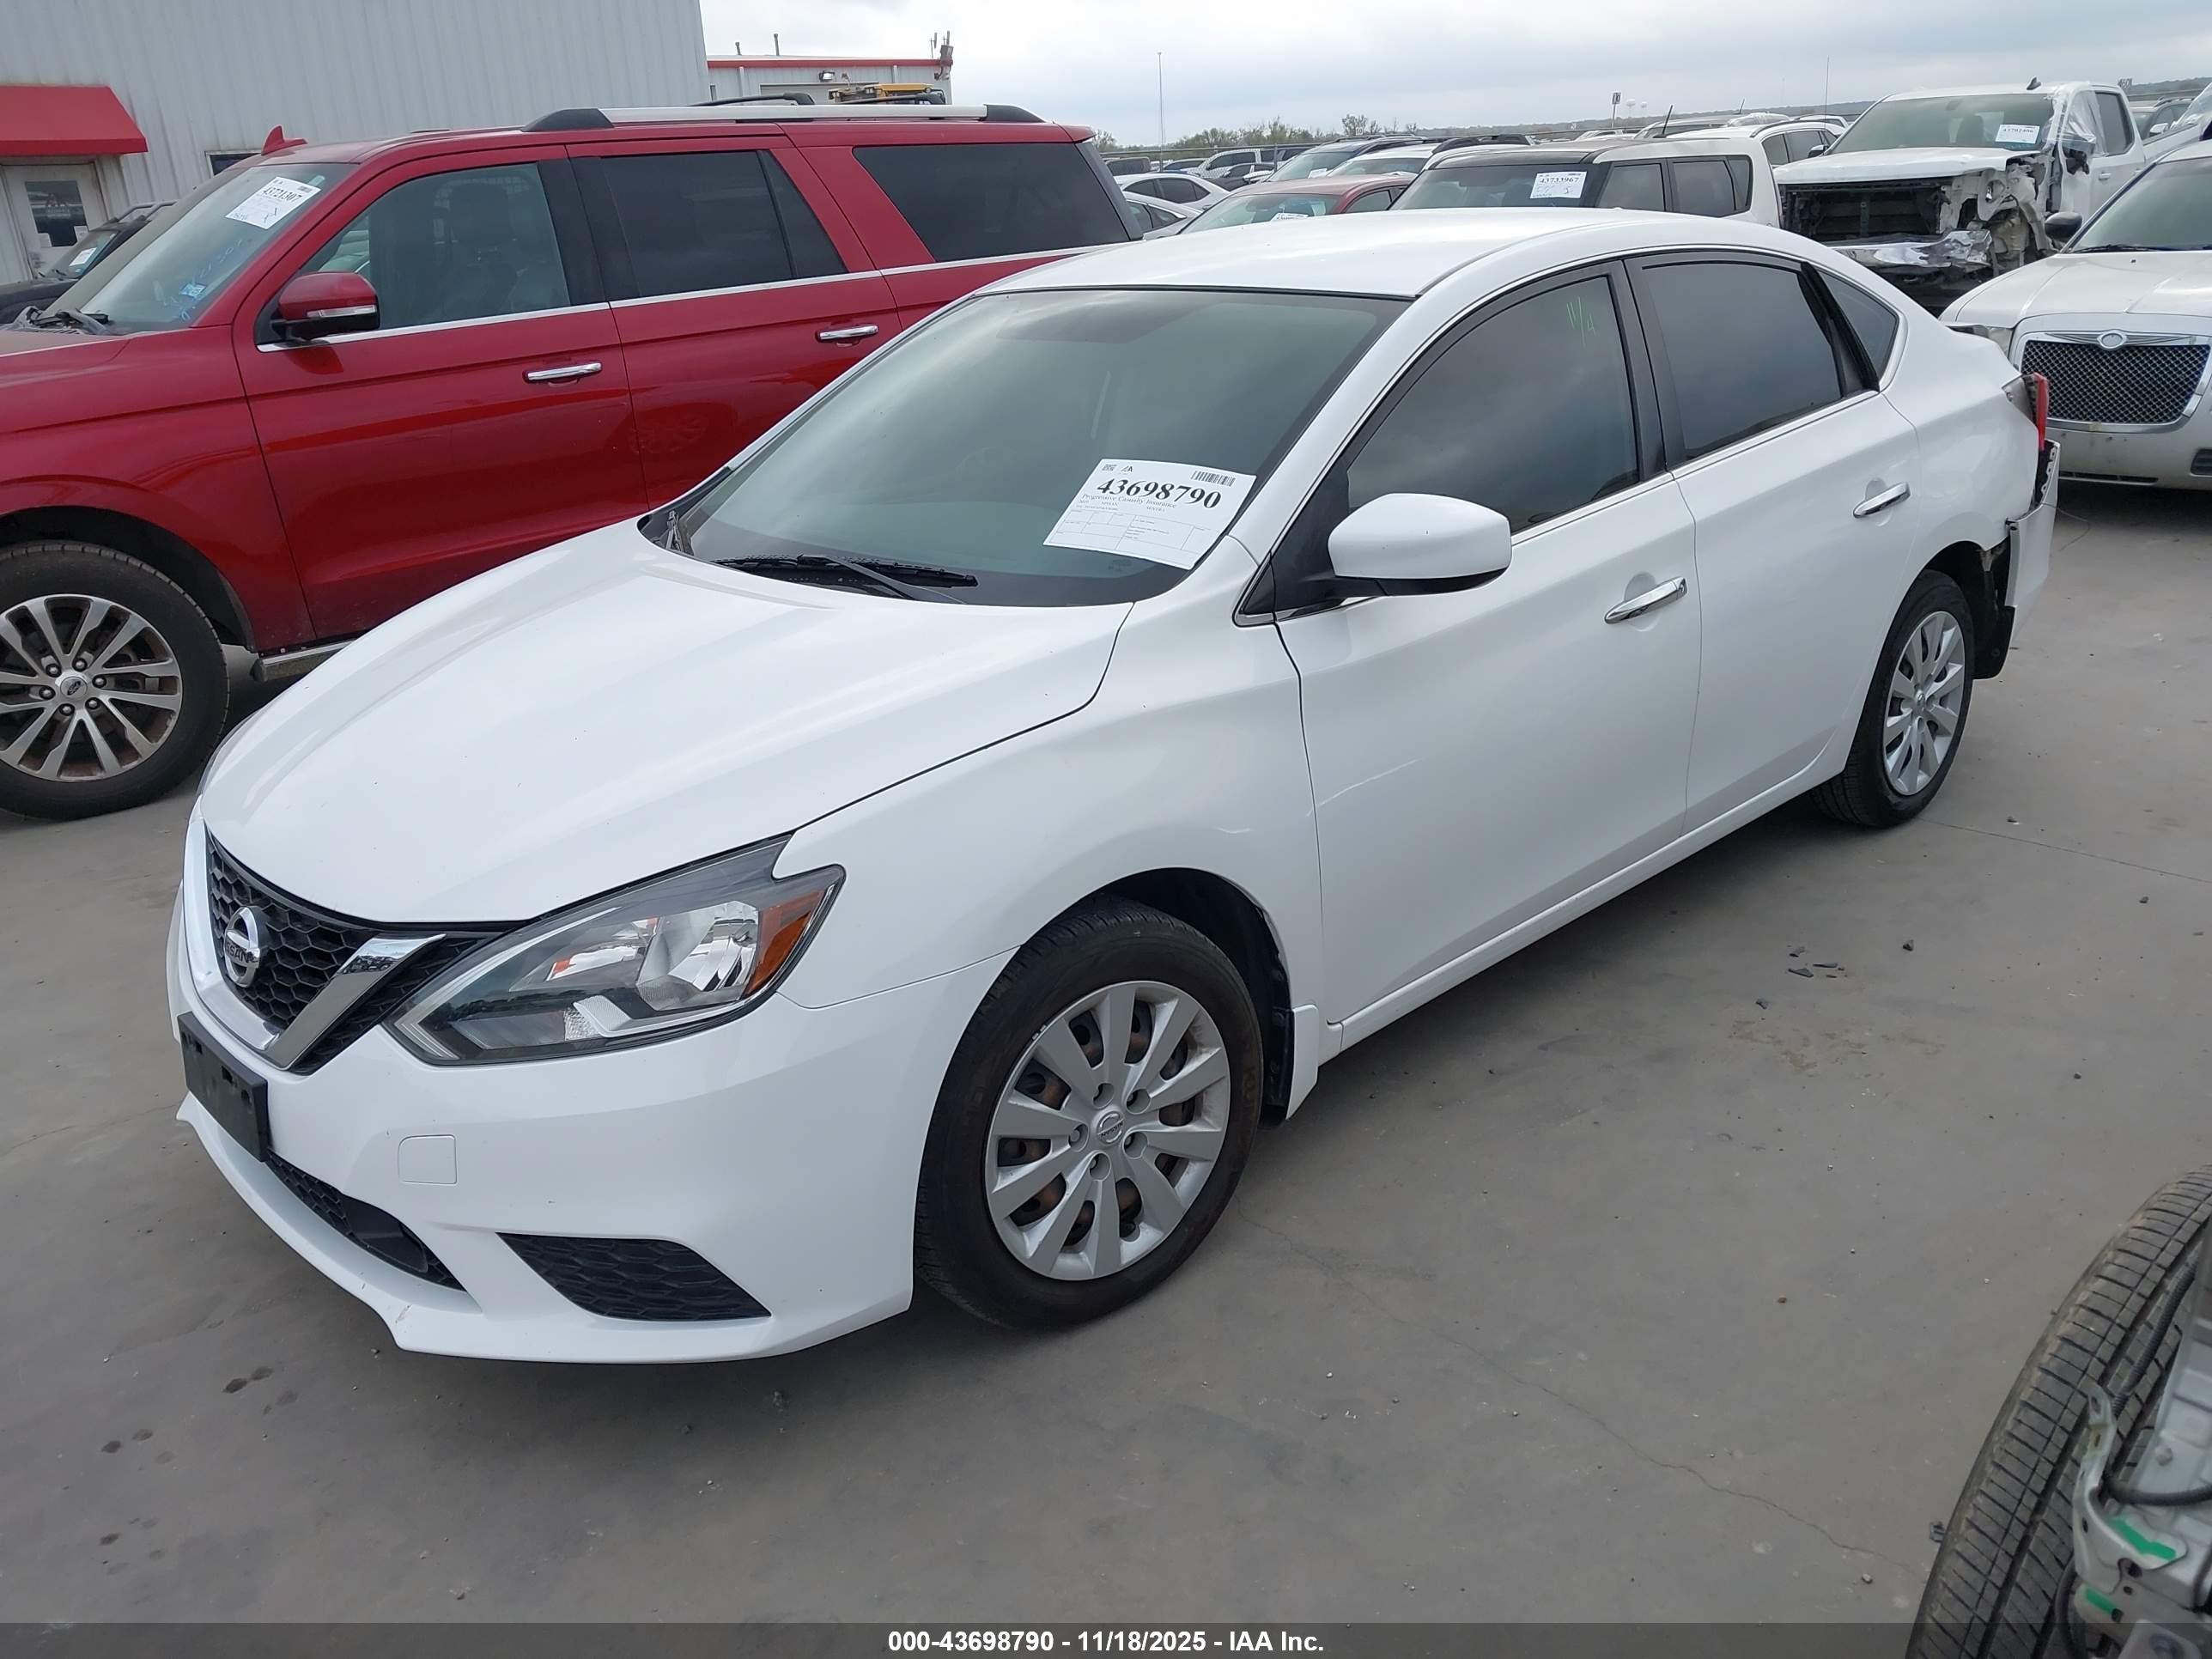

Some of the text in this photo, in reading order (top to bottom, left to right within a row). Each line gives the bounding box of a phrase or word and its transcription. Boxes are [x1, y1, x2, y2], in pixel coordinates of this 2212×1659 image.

[1097, 477, 1222, 508] 43698790
[1118, 496, 1145, 505] Casualty
[1146, 499, 1177, 509] Insurance
